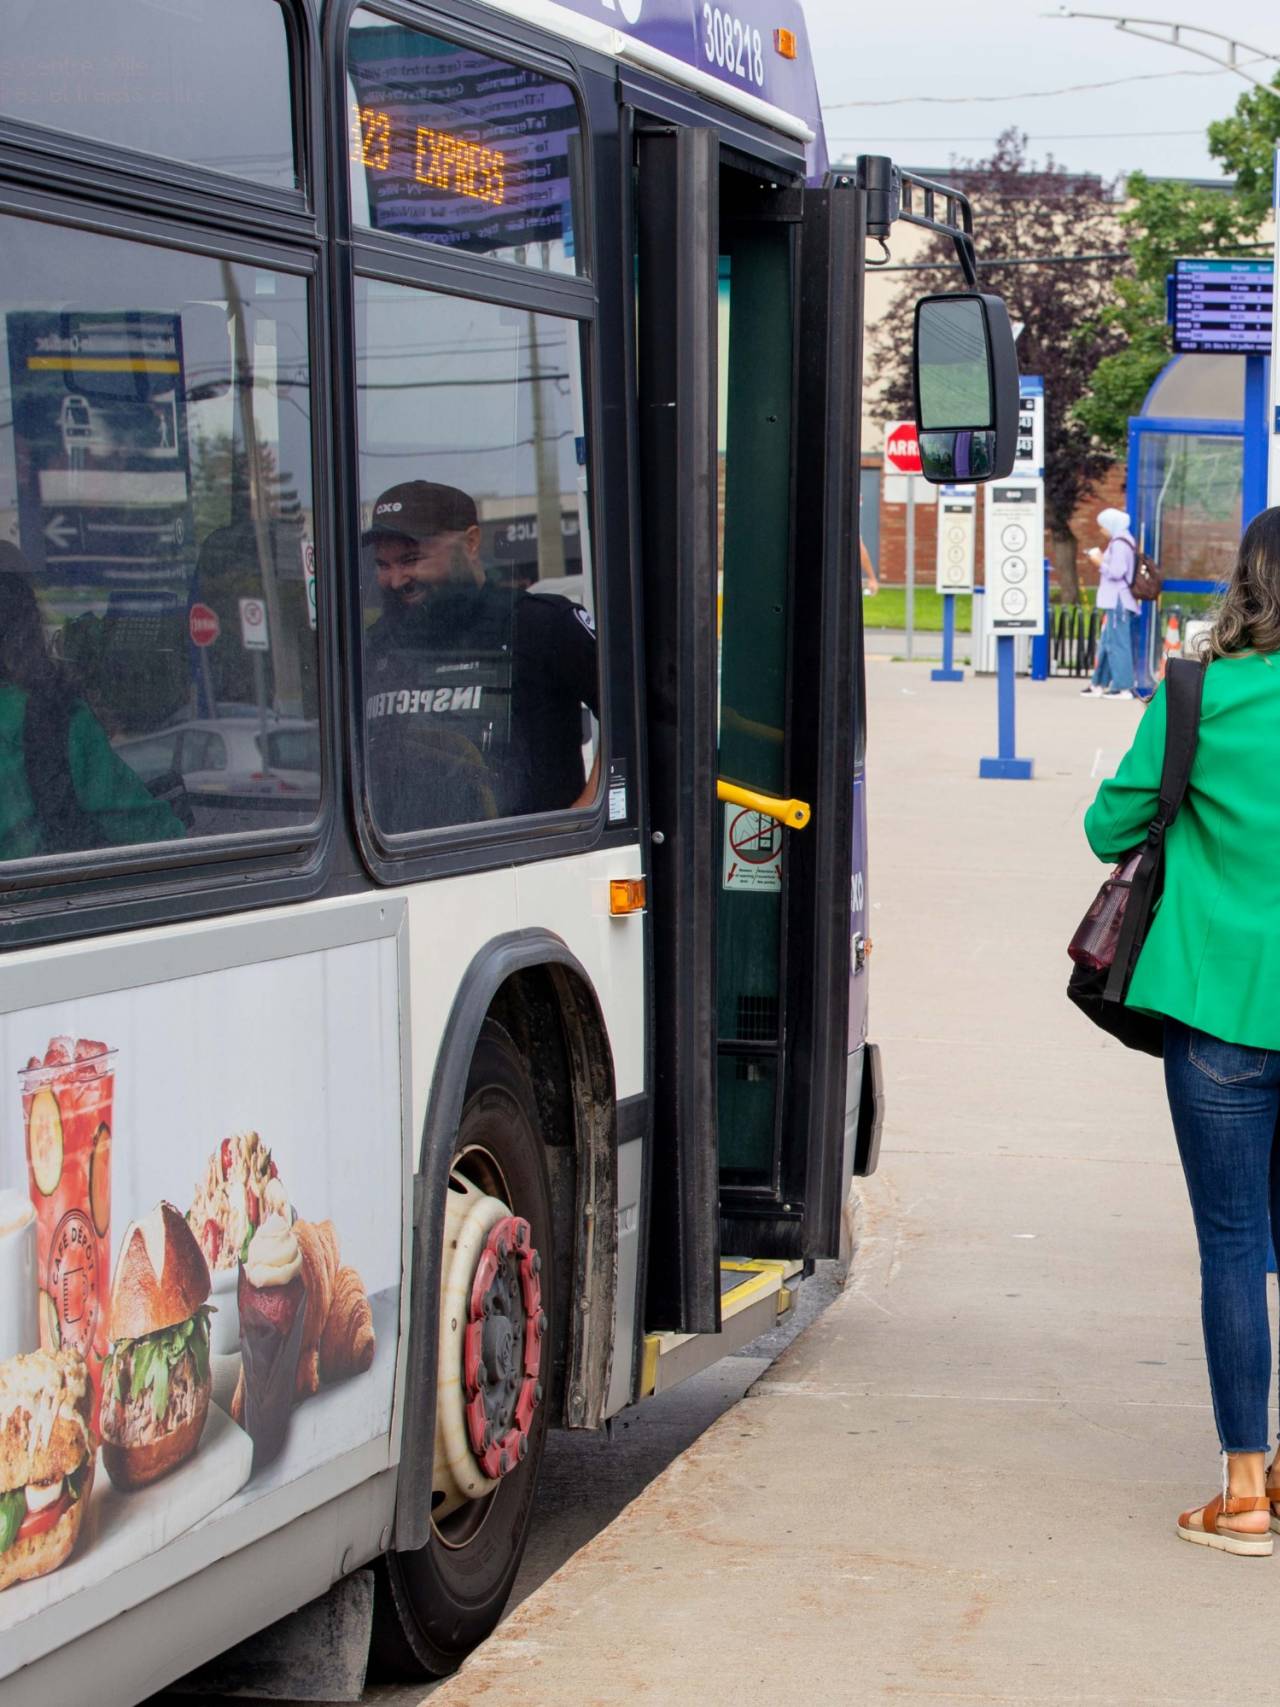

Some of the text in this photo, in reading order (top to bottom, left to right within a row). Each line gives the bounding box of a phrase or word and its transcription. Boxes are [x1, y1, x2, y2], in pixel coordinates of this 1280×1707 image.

[703, 3, 764, 87] 308218
[416, 124, 504, 206] EXPRESS
[888, 440, 919, 456] ARR
